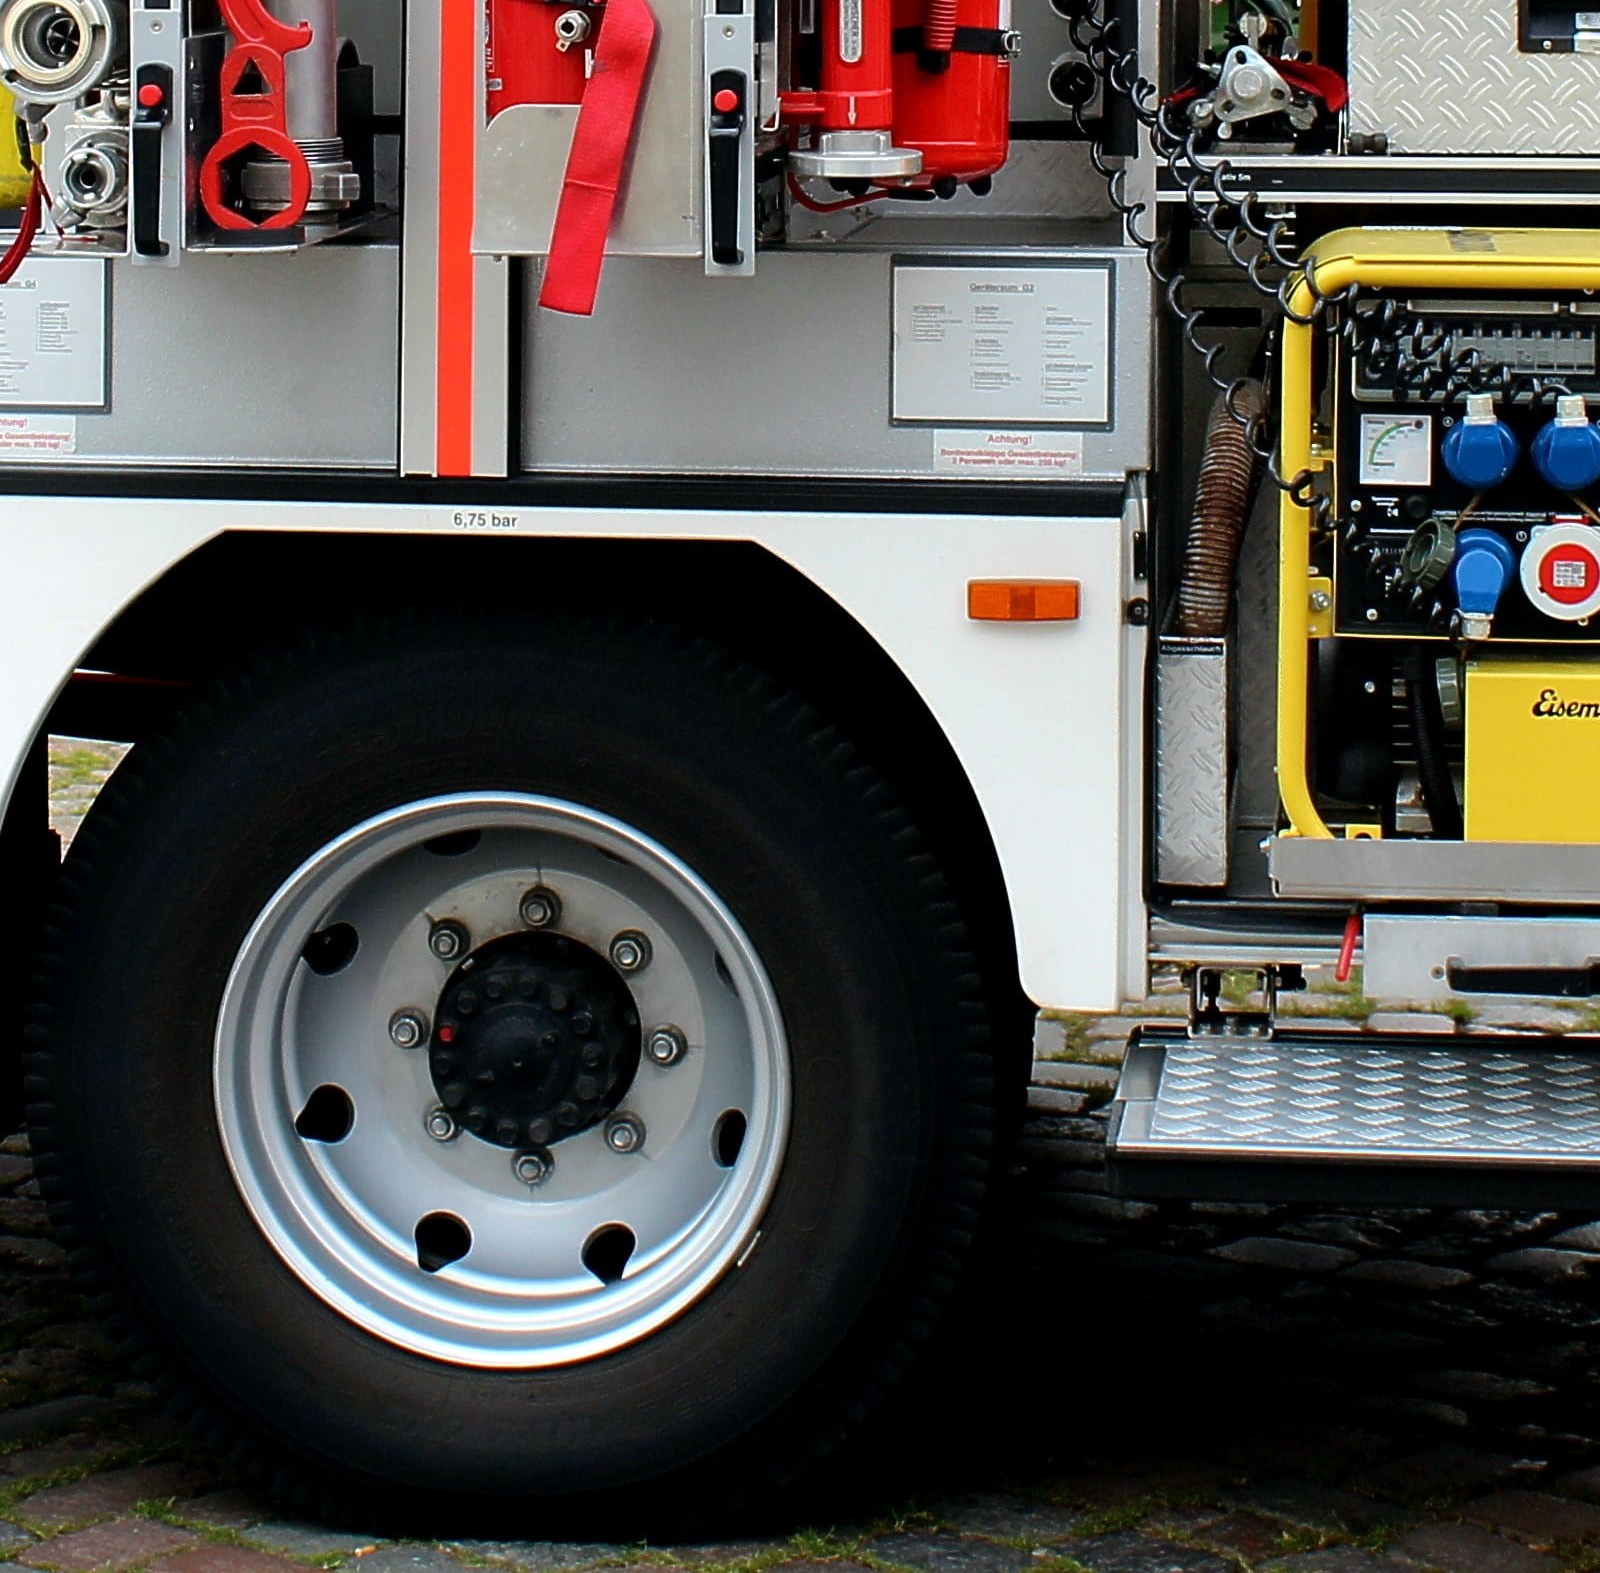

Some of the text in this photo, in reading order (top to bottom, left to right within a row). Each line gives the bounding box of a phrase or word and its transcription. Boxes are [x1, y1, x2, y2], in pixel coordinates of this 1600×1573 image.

[969, 283, 1035, 292] Geräteraum G2
[987, 434, 1033, 446] Achtung!
[998, 458, 1016, 466] oder
[453, 512, 519, 529] 6,75 bar
[1160, 644, 1222, 653] Abgasschlauch
